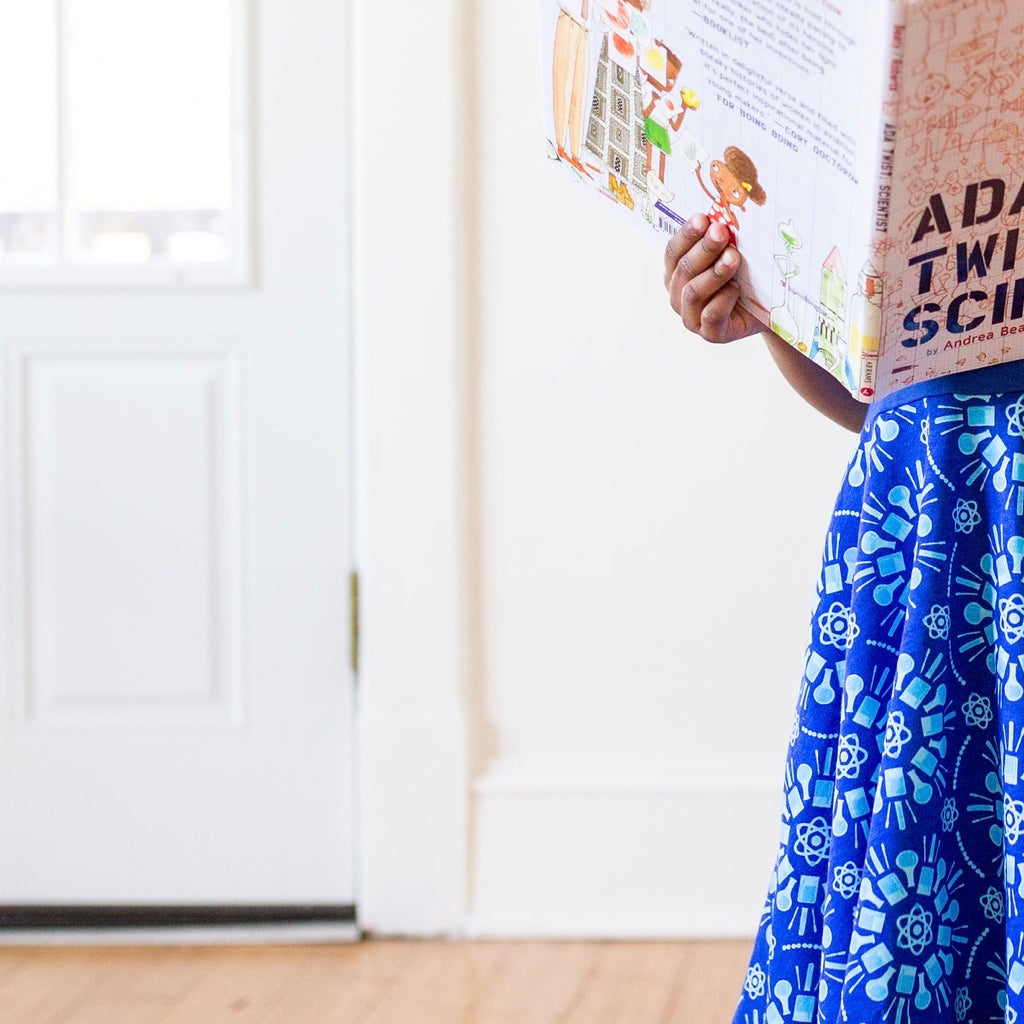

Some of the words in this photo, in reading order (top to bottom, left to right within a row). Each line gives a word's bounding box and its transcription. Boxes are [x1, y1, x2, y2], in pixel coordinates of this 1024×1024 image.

[716, 93, 734, 110] FOR
[739, 107, 766, 131] BOING
[771, 128, 798, 153] BOING
[883, 123, 896, 142] ADA
[876, 185, 891, 233] SCIENTIST
[926, 345, 939, 357] by
[943, 330, 994, 351] Andrea
[864, 361, 873, 383] ABRAMS
